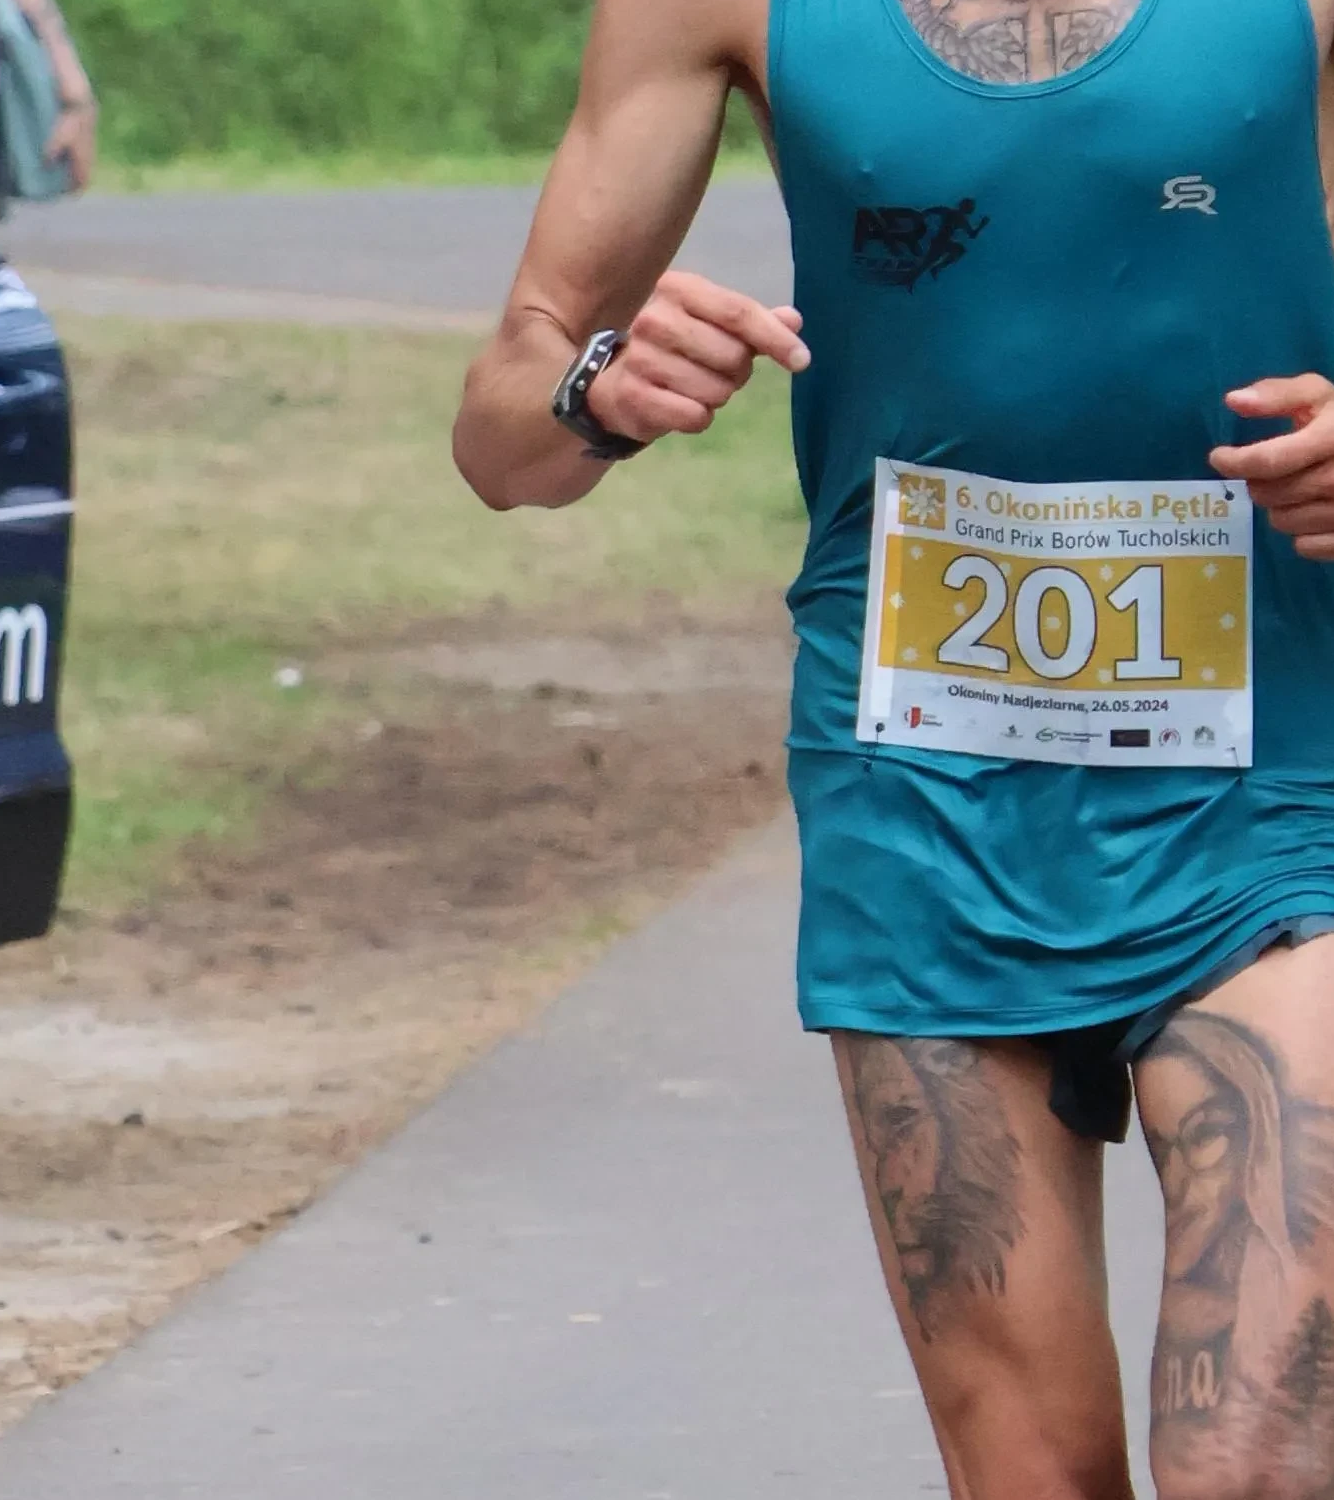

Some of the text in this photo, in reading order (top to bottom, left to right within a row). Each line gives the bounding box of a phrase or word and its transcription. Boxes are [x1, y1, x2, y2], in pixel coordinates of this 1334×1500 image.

[956, 486, 1229, 524] 6. Okonińska Pętla
[955, 518, 1230, 549] Grand Prix Borów Tucholskich
[936, 553, 1183, 681] 201
[947, 684, 1000, 705] Okoniny
[1091, 699, 1170, 713] 26.05.2024
